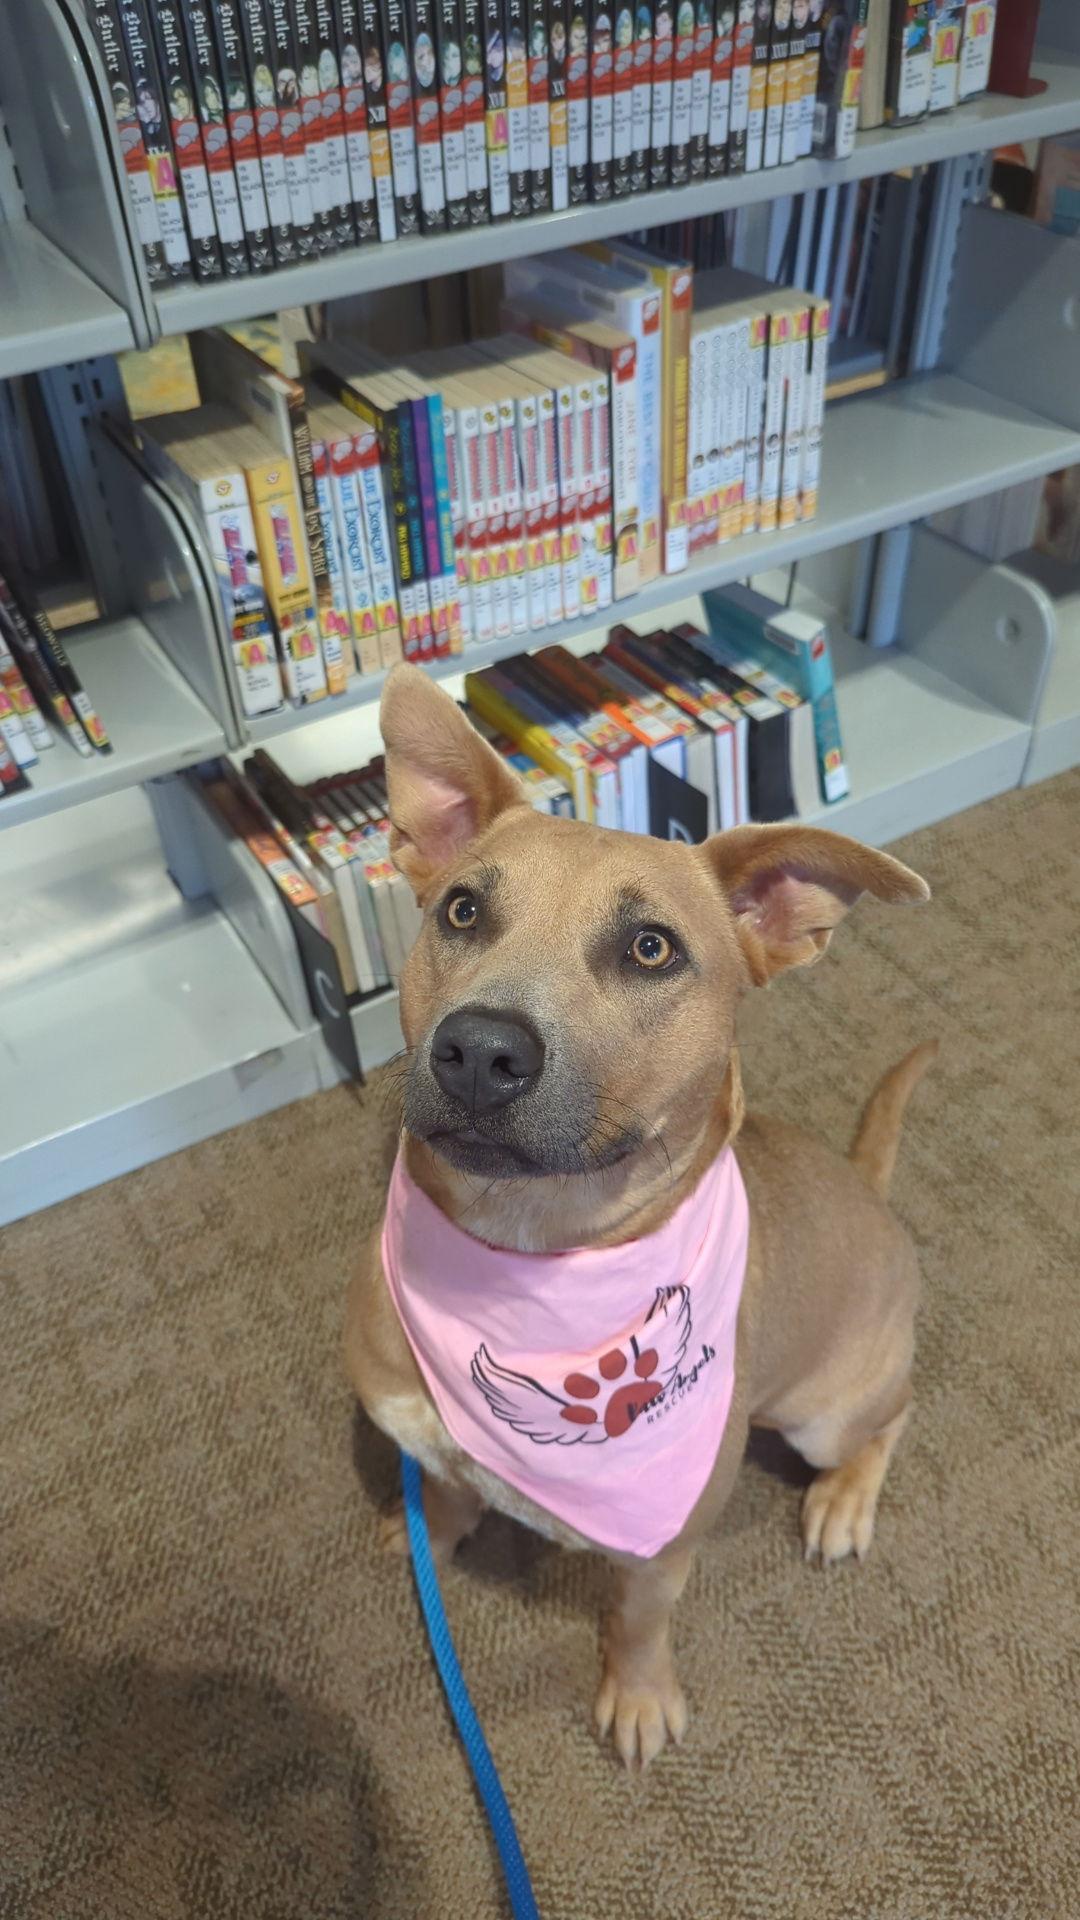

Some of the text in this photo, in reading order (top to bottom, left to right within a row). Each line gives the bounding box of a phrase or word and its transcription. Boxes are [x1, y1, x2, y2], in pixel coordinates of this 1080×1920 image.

[96, 15, 121, 72] Butler
[123, 11, 148, 68] Butler
[158, 9, 182, 66] Butler
[189, 10, 211, 66] Butler
[217, 3, 239, 59] Butler
[245, 0, 266, 54] Butler
[626, 402, 637, 437] JANE
[670, 1344, 716, 1396] Angels
[646, 1383, 694, 1425] RESCUE
